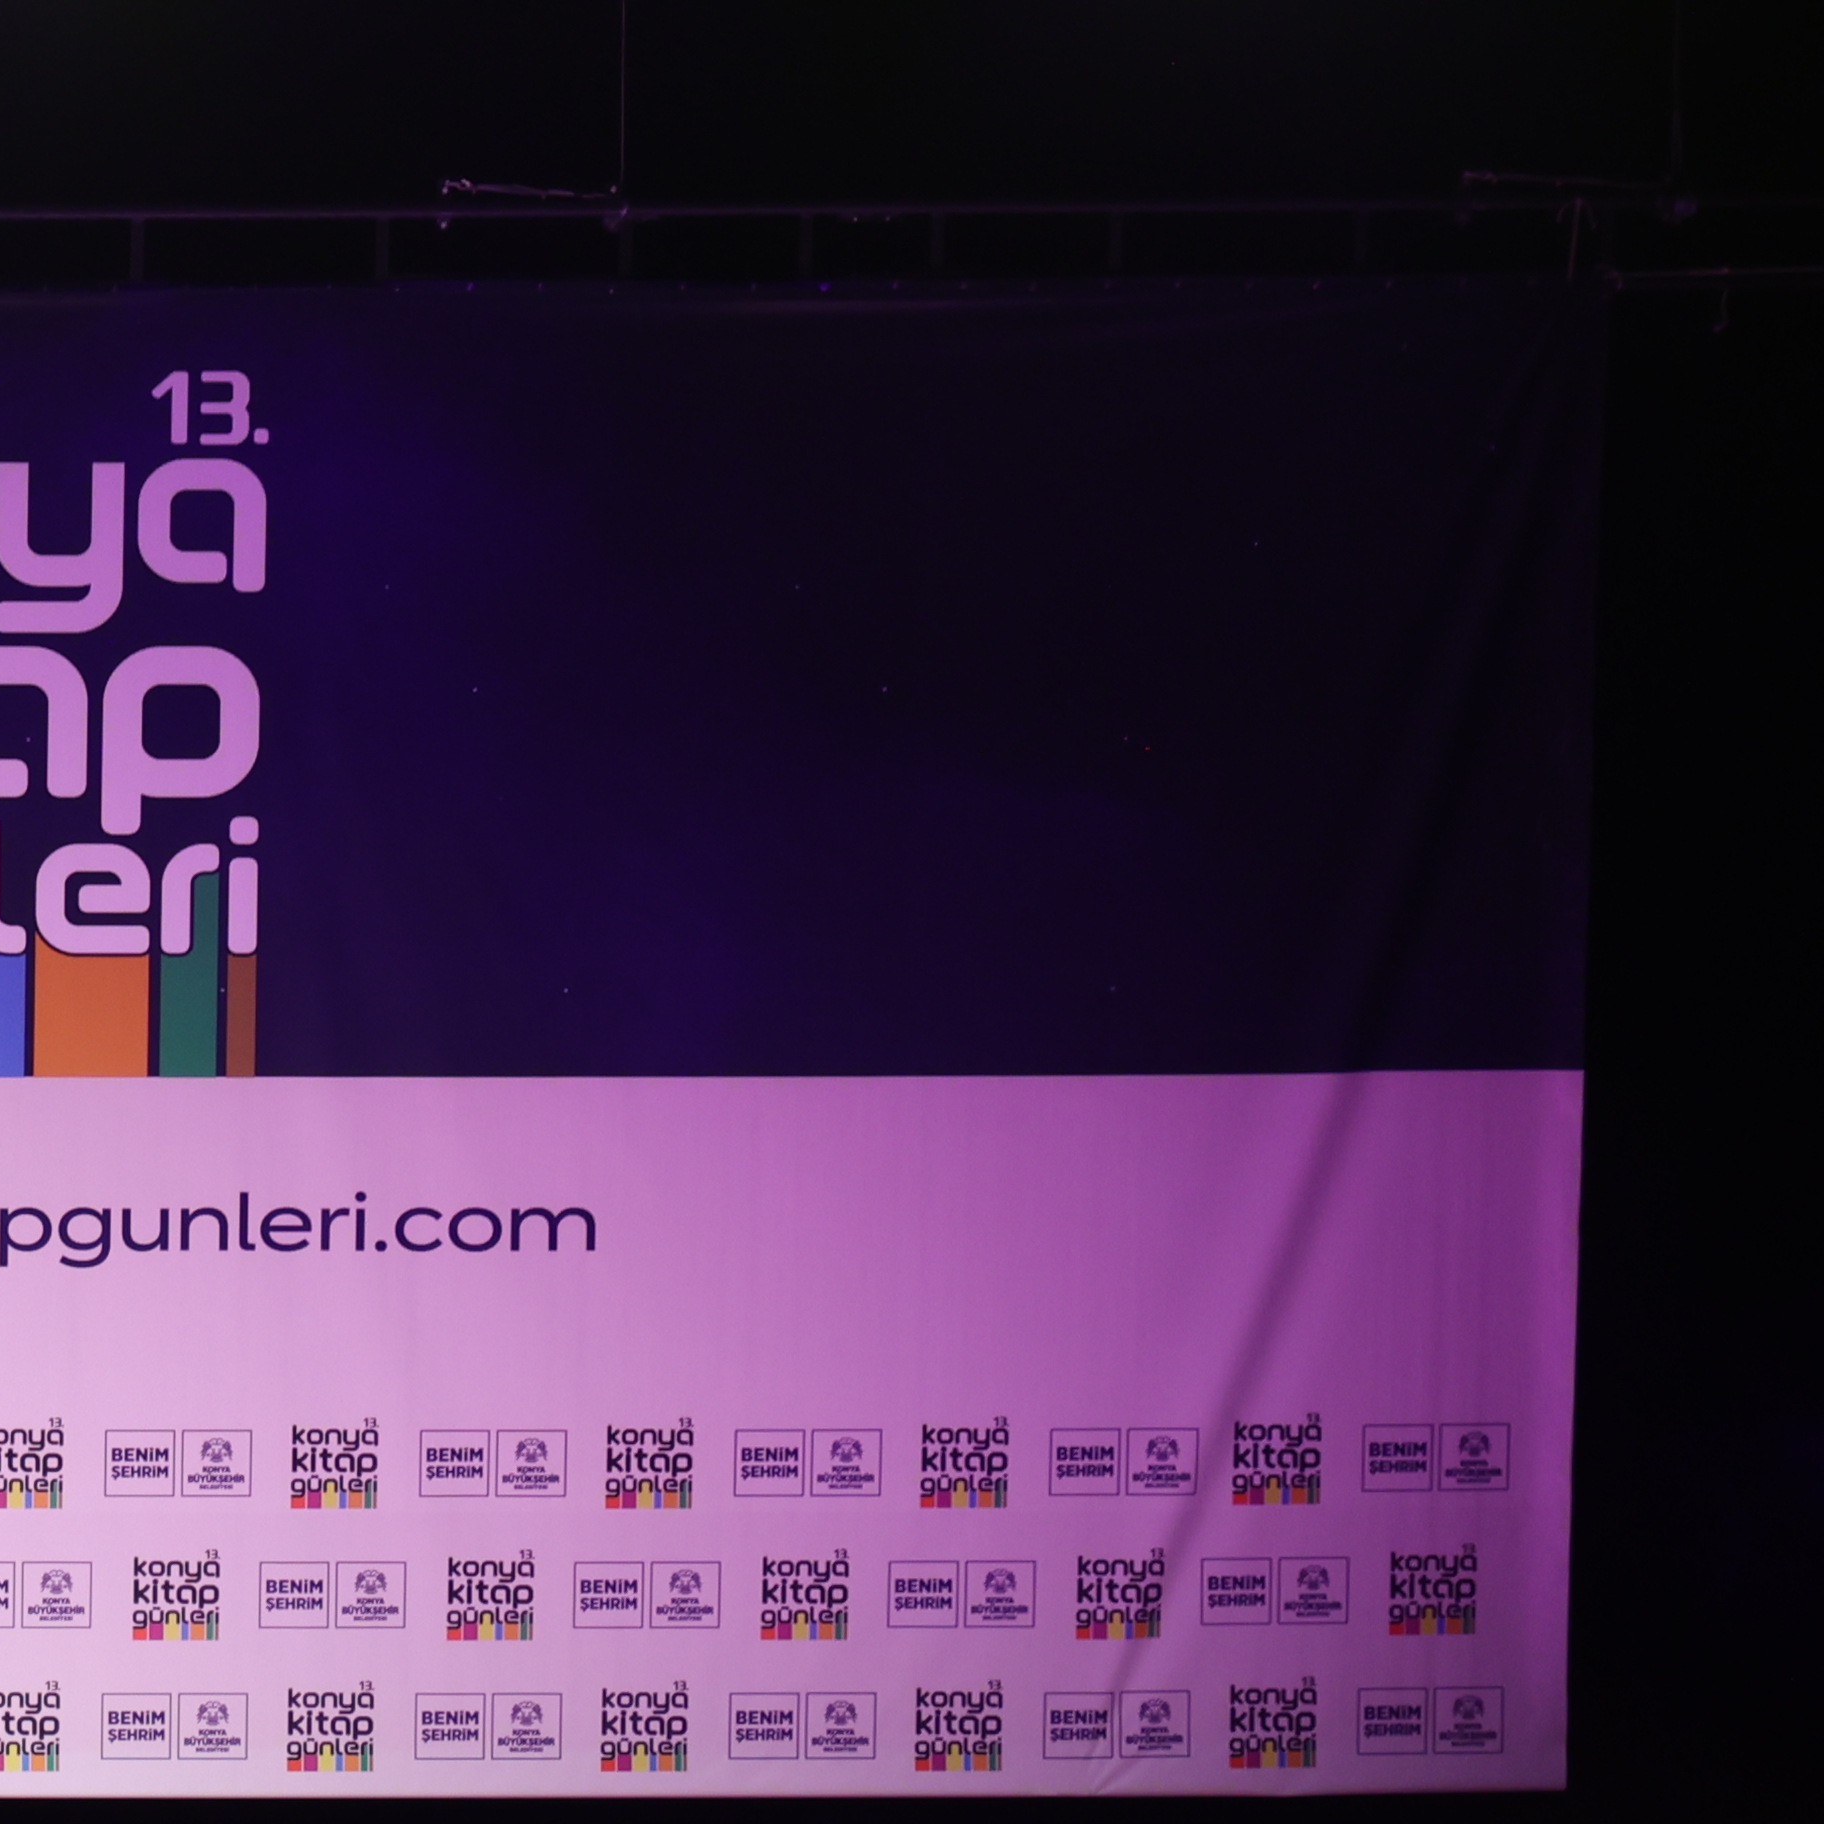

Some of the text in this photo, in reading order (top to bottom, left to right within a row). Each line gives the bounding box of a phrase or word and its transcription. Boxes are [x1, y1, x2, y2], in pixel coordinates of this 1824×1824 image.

[153, 372, 269, 444] 13.
[292, 1425, 378, 1451] konya
[607, 1425, 693, 1451] konya
[922, 1424, 1008, 1450] konya
[1234, 1420, 1321, 1446] konya
[292, 1447, 377, 1477] kitap
[607, 1447, 692, 1477] kitap
[922, 1446, 1007, 1476] kitap
[1234, 1442, 1320, 1473] kitap
[134, 1557, 219, 1583] konya
[448, 1557, 534, 1583] konya
[1078, 1555, 1165, 1581] konya
[134, 1579, 218, 1608] kitap
[448, 1579, 533, 1609] kitap
[1078, 1577, 1164, 1608] kitap
[602, 1688, 688, 1714] konya
[1231, 1685, 1316, 1711] konya
[602, 1710, 687, 1740] kitap
[1231, 1707, 1315, 1736] kitap
